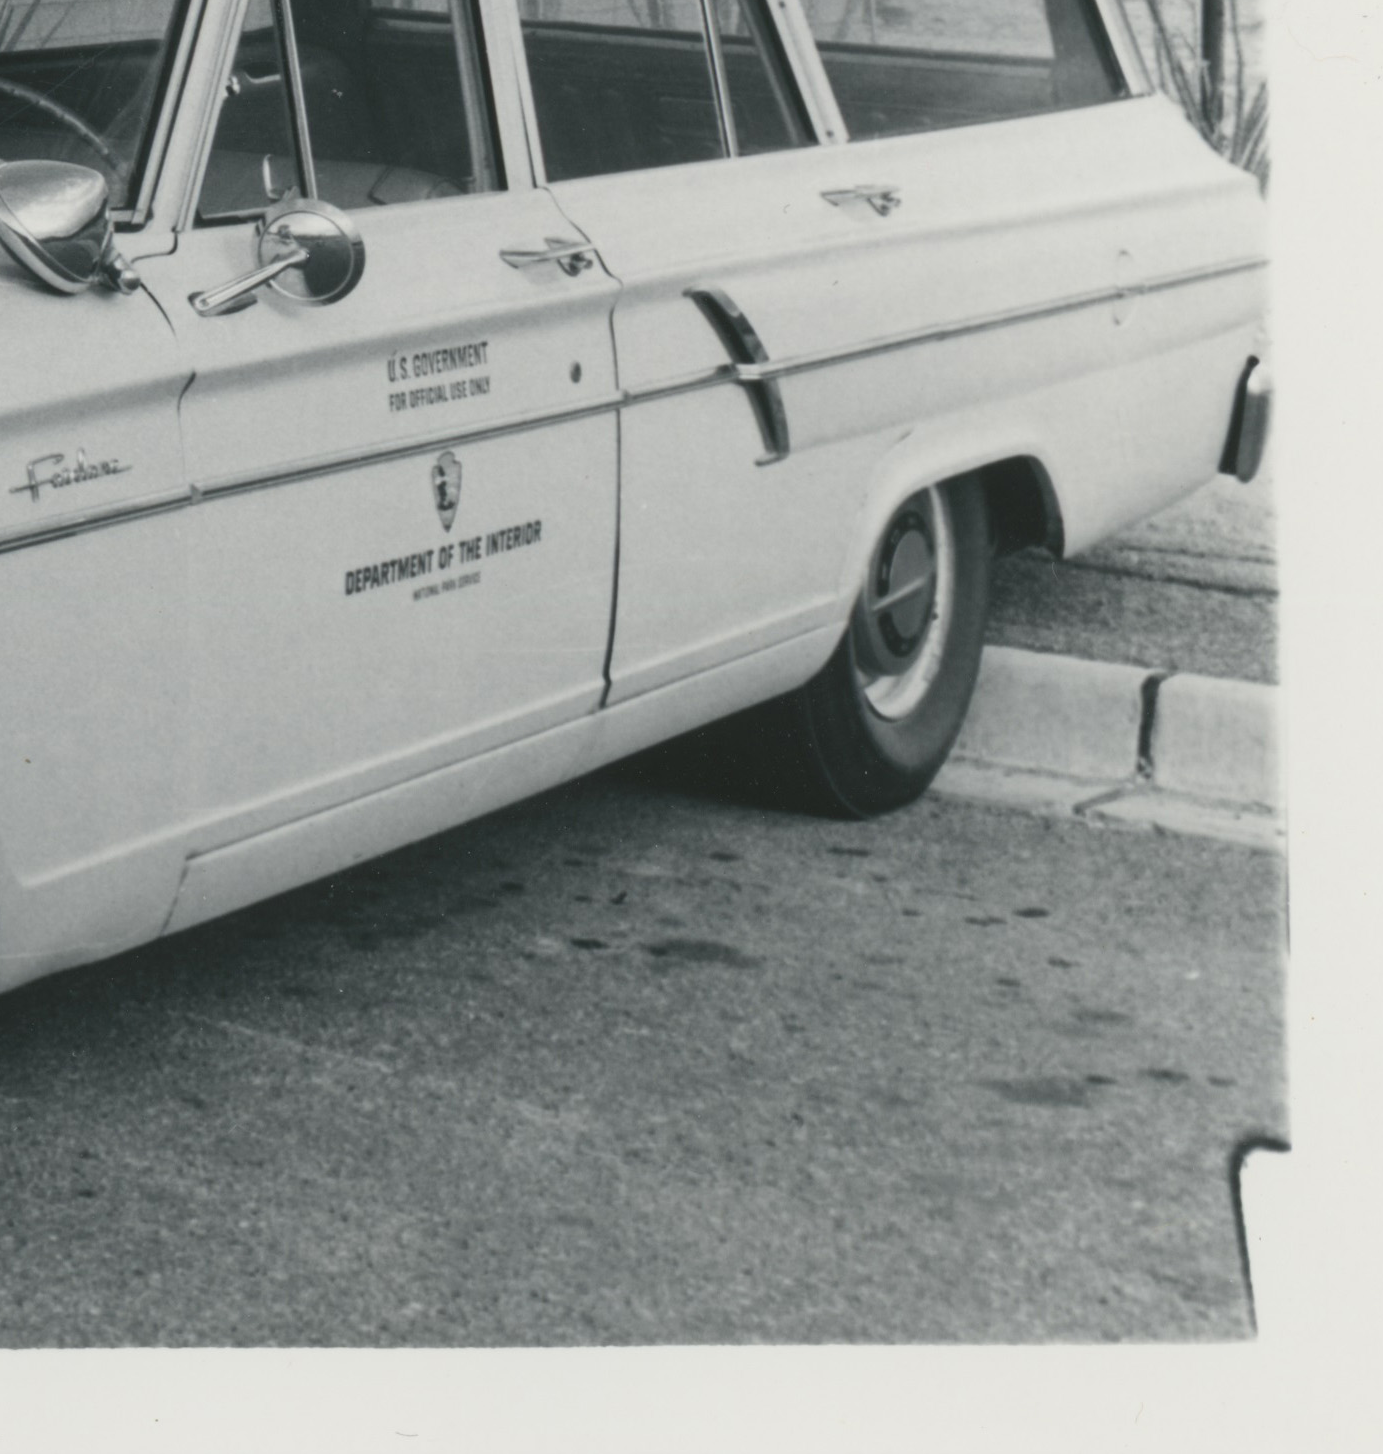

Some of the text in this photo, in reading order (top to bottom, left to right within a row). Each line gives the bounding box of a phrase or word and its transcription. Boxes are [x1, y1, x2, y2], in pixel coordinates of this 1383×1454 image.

[386, 341, 489, 383] U.S. GOVERNMENT
[388, 376, 491, 413] FOR OFFICIAL USE ONLY
[344, 519, 542, 596] DEPARTMENT OF THE INTERIOR
